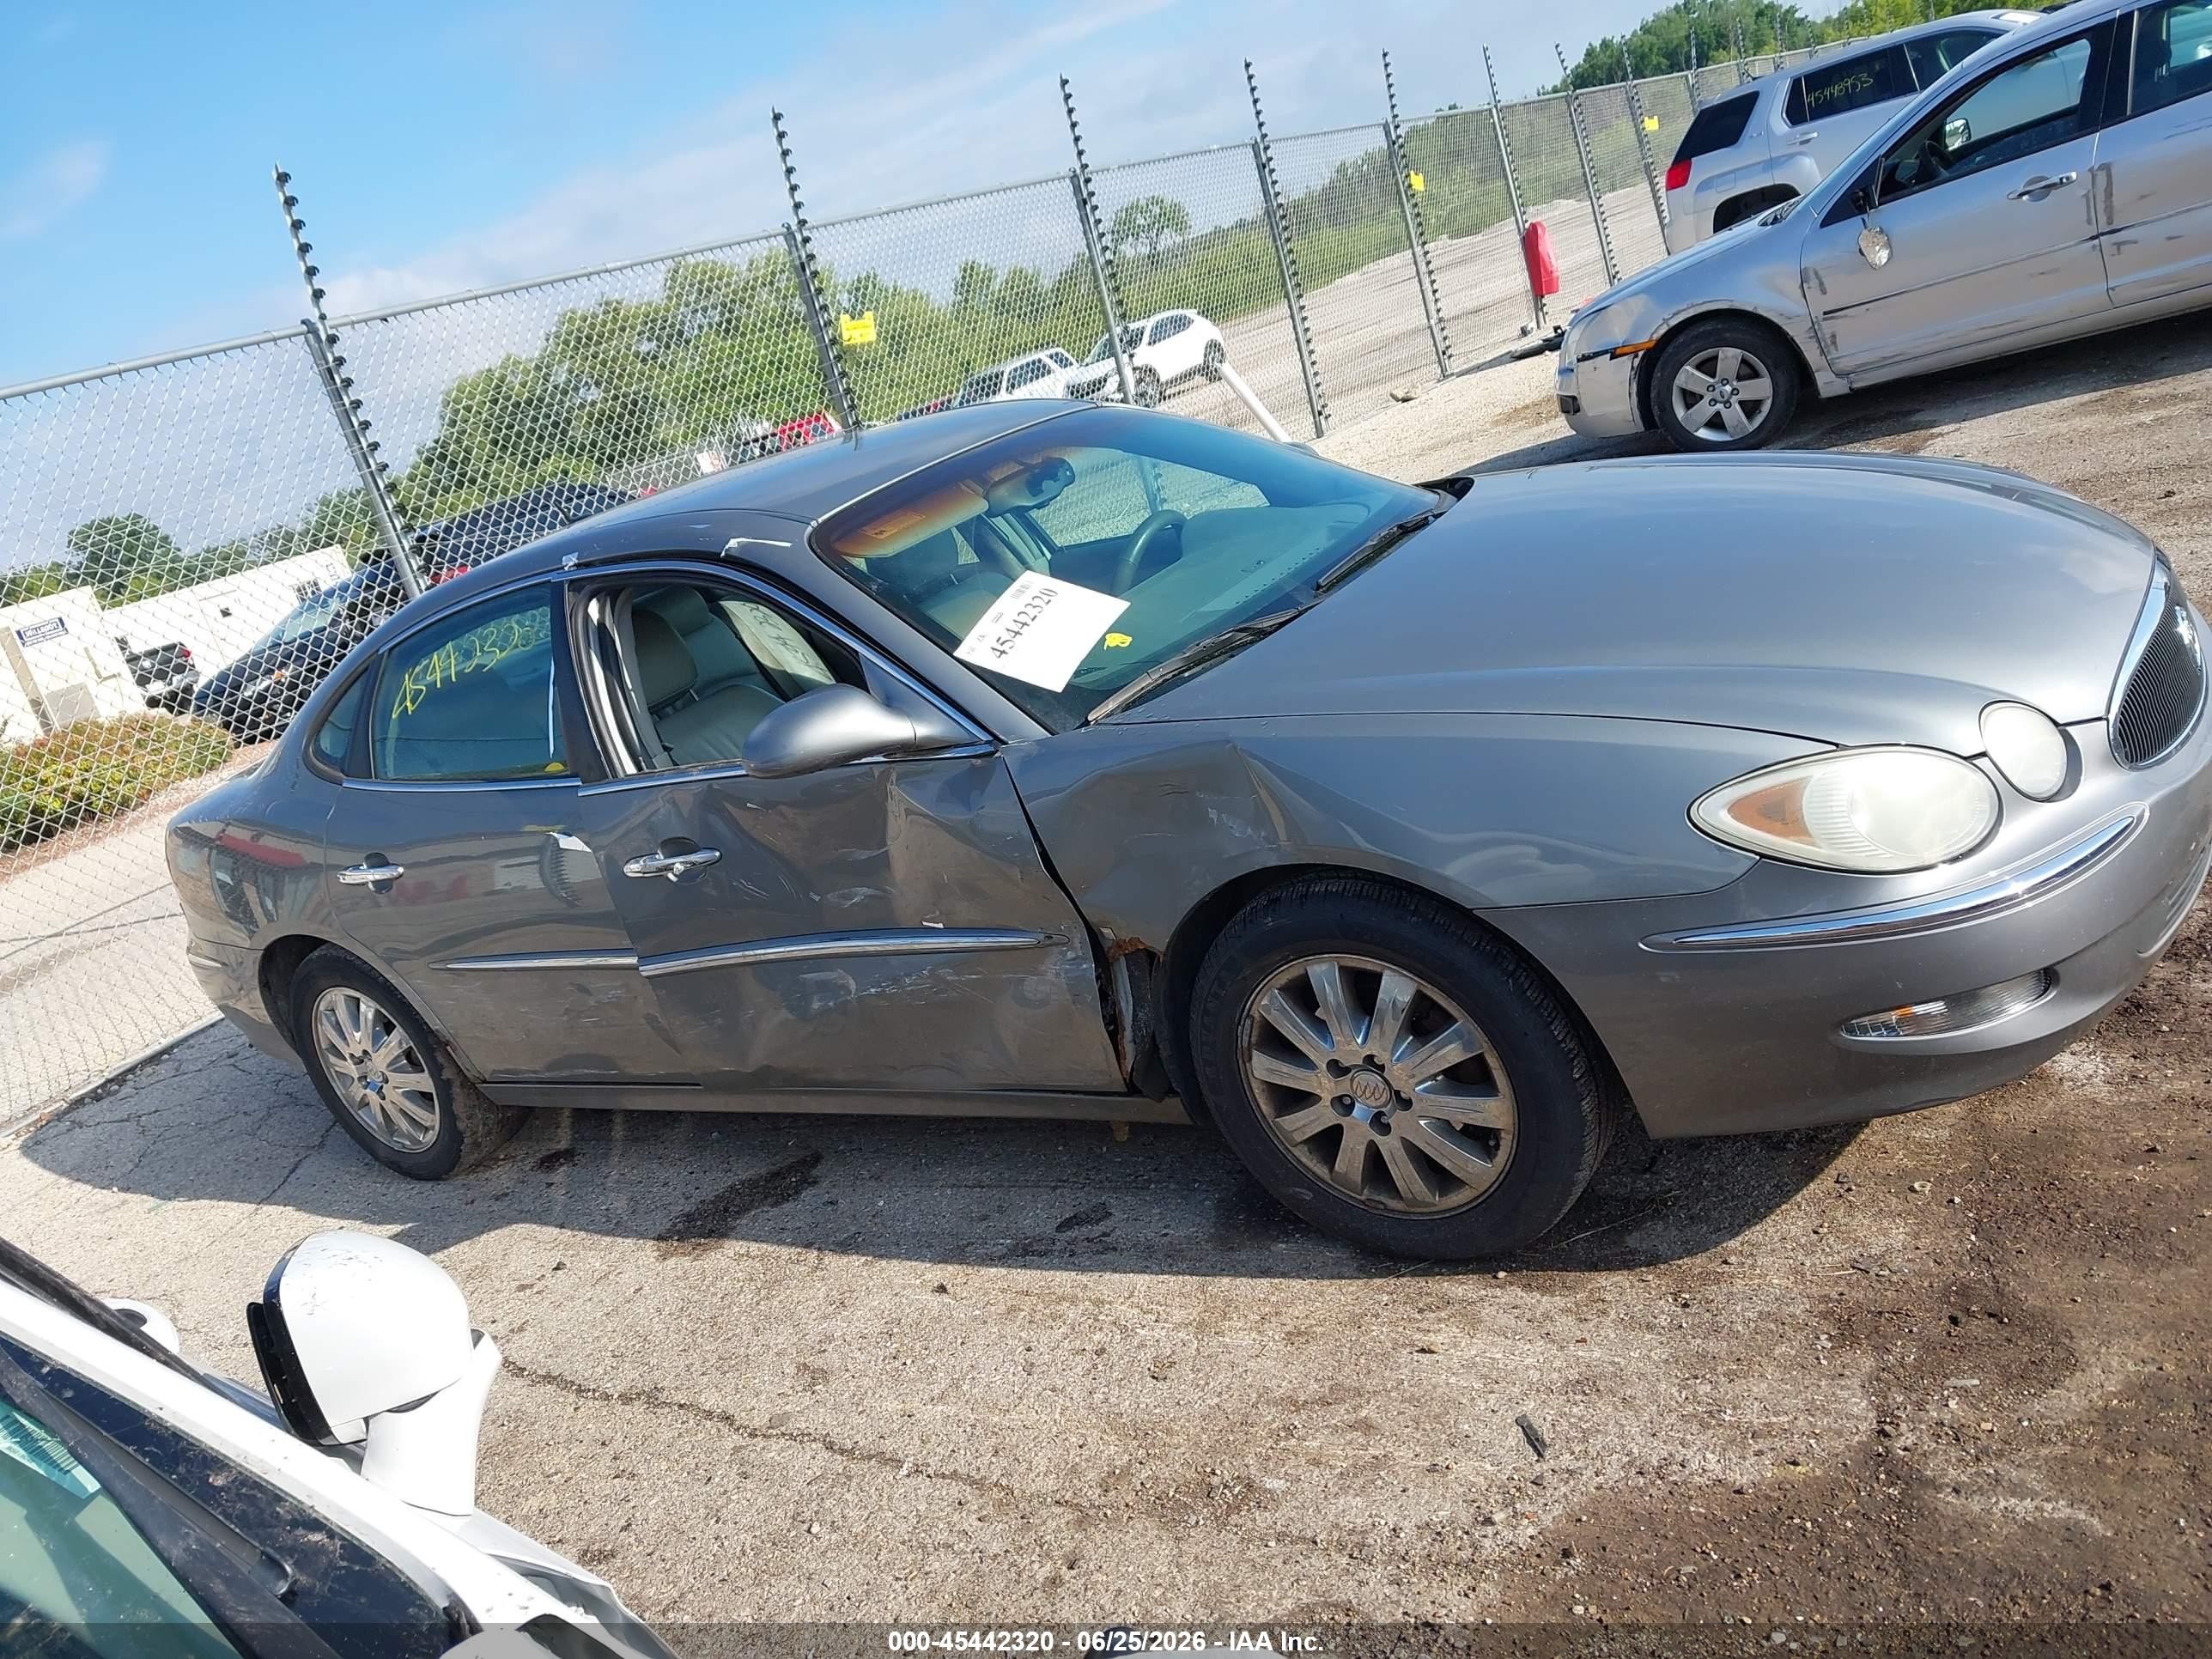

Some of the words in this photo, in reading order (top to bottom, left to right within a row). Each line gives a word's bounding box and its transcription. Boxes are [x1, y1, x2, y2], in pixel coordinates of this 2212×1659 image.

[1807, 72, 1874, 109] 45448953
[990, 587, 1059, 659] 45442320
[392, 623, 537, 720] 45442320
